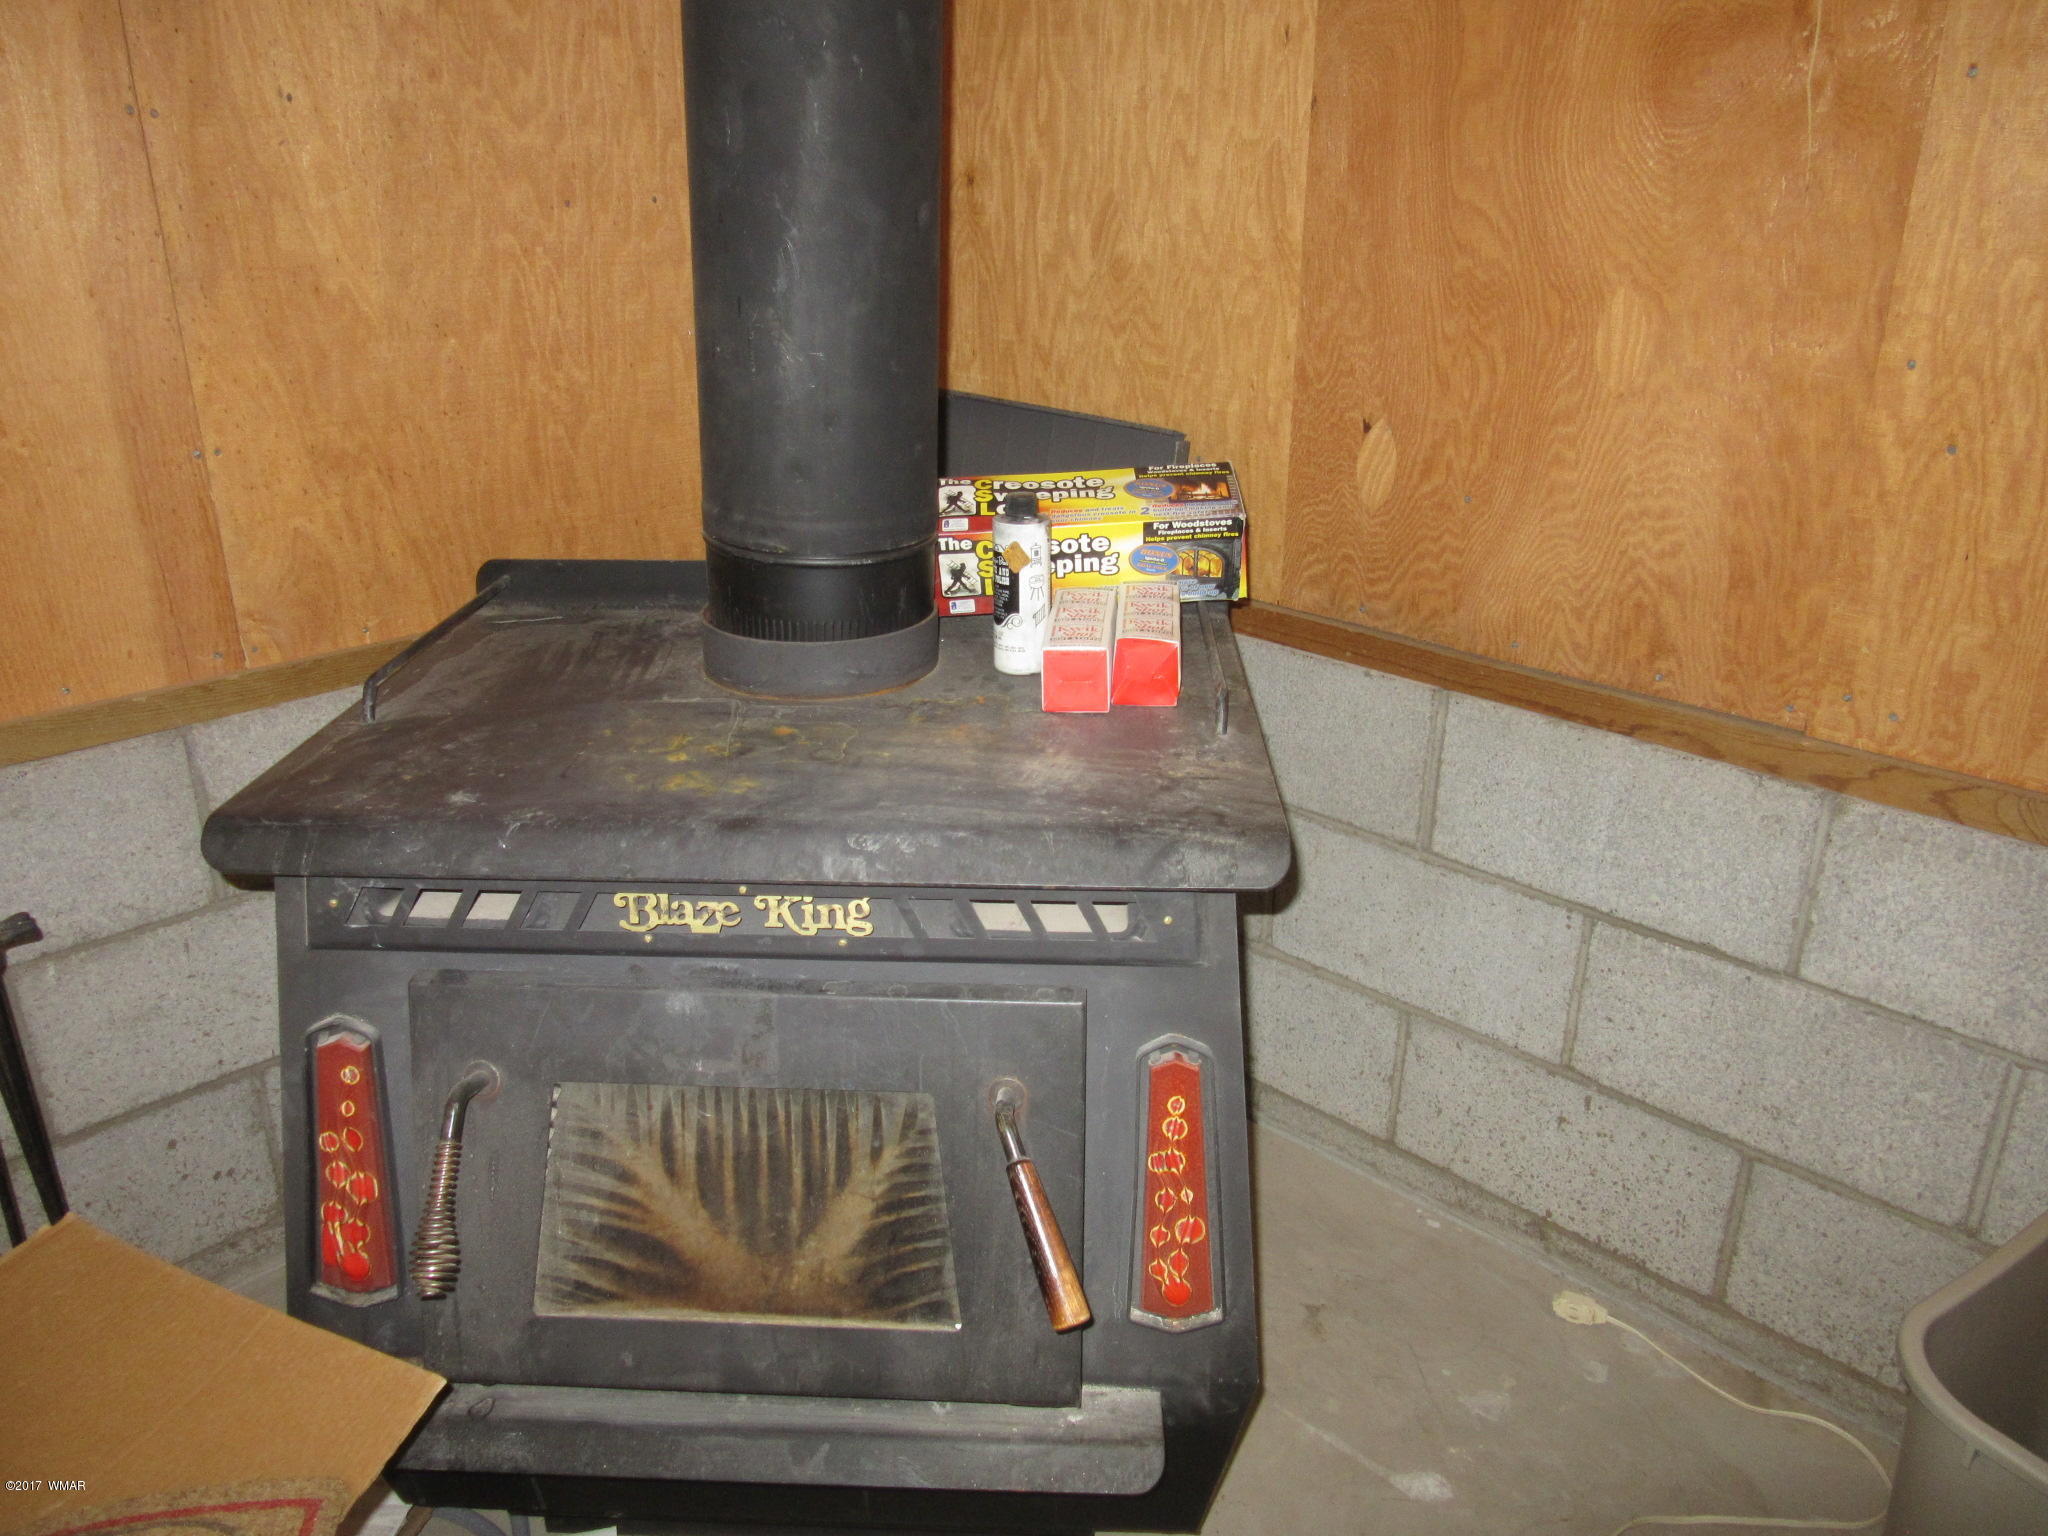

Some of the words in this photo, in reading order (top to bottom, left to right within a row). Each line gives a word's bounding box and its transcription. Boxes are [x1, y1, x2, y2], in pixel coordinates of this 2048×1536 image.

[1166, 462, 1217, 470] Fireplaces
[975, 476, 1104, 490] Creosote
[1140, 507, 1150, 515] 2
[1153, 522, 1169, 530] For
[1171, 519, 1233, 529] Woodstoves
[938, 537, 973, 551] The
[613, 892, 742, 934] Blaze
[753, 894, 875, 937] King
